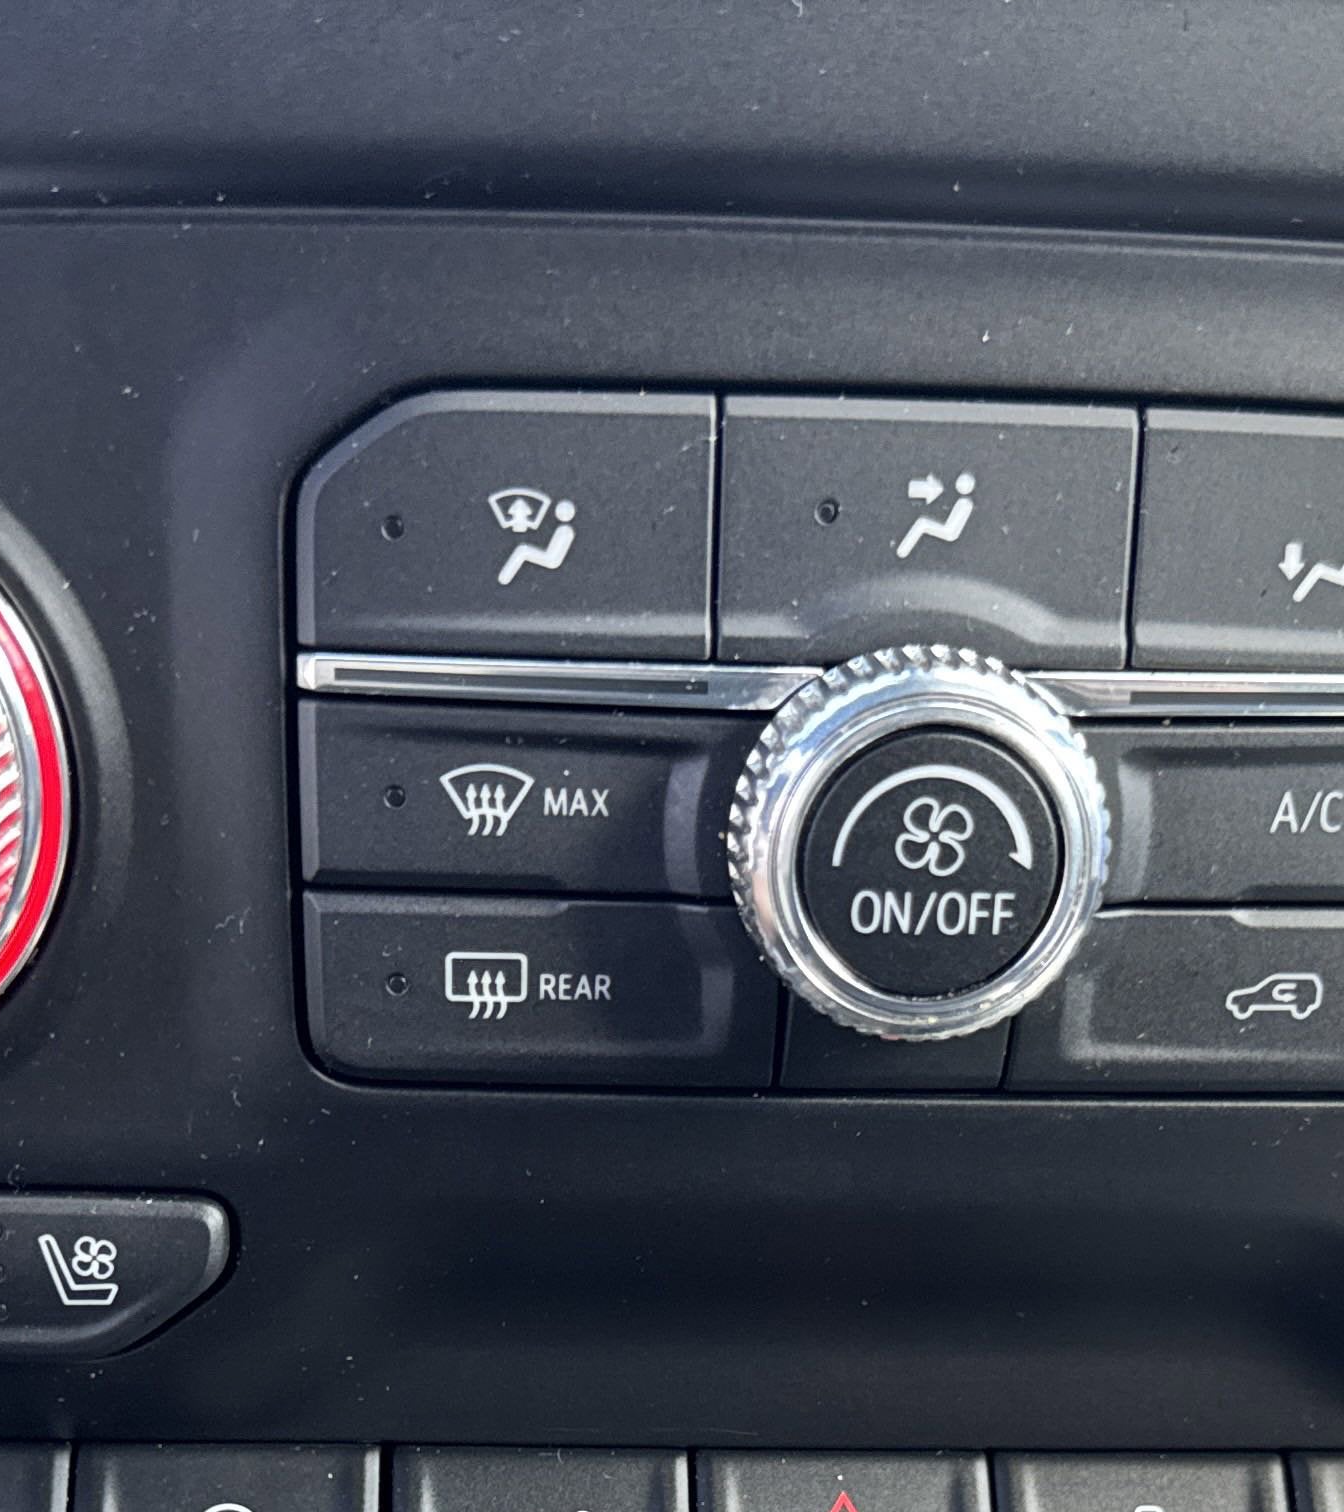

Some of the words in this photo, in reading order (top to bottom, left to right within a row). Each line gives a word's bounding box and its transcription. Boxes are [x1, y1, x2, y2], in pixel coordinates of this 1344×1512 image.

[543, 787, 610, 817] MAX
[1269, 789, 1344, 835] A/C
[850, 891, 1016, 937] ON/OFF
[538, 973, 612, 1001] REAR
